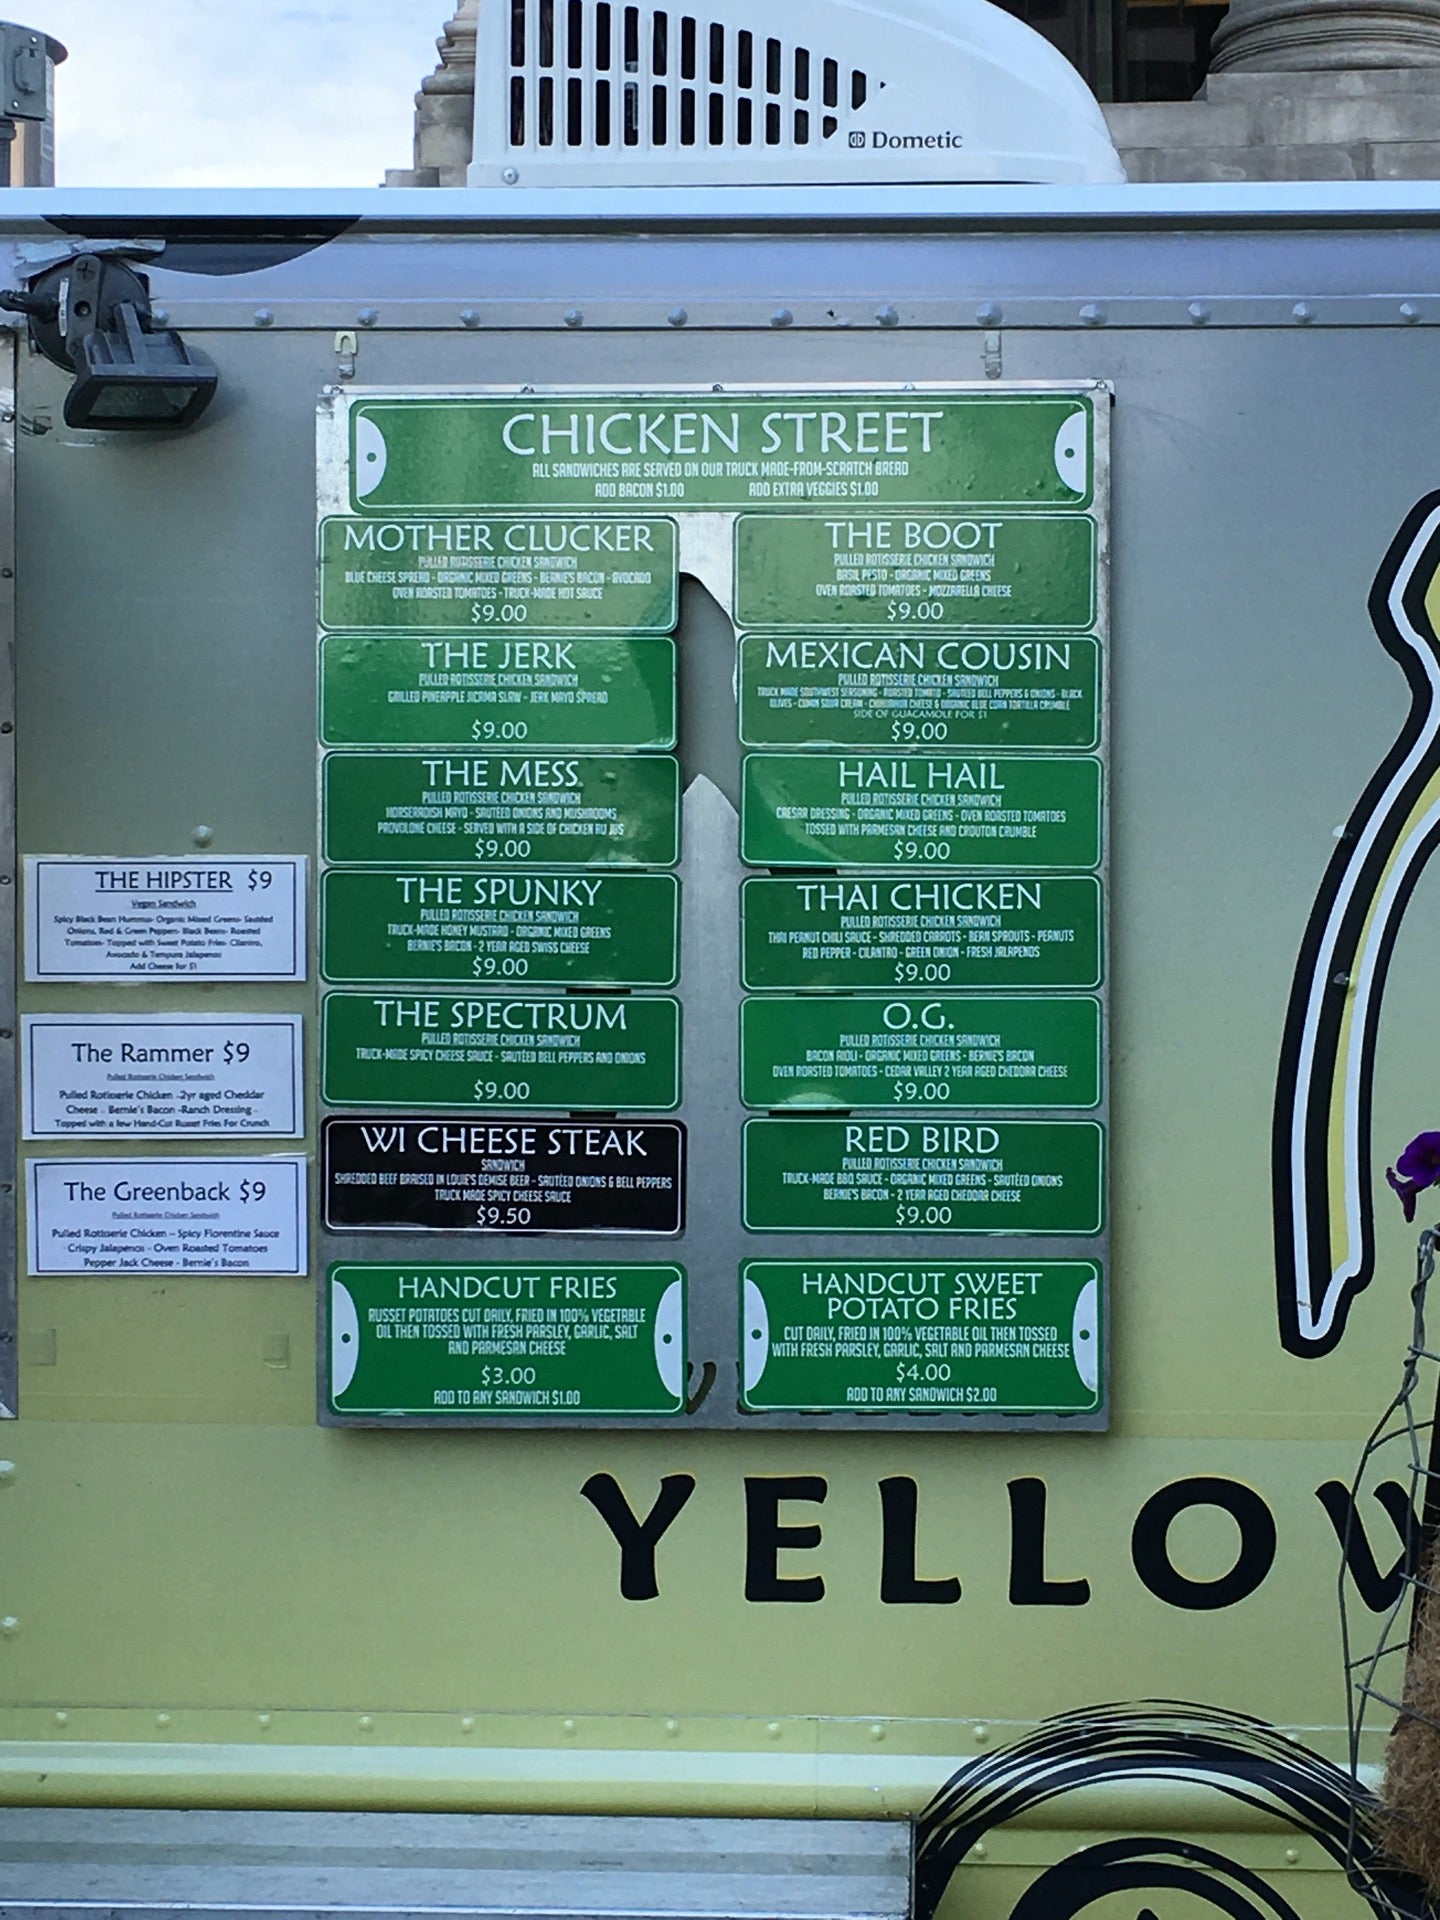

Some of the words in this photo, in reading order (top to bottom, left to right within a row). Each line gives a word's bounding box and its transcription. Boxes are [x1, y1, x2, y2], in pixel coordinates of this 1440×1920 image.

[872, 131, 962, 149] Dometic
[503, 413, 739, 455] CHICKEN
[761, 411, 944, 453] STREET
[532, 463, 551, 478] ALL
[552, 462, 619, 478] SANDWICHES
[621, 462, 641, 478] ARE
[643, 462, 682, 477] SERVED
[684, 462, 699, 477] ON
[701, 462, 723, 477] OUR
[725, 461, 759, 477] TRUCK
[761, 461, 873, 476] MADE-FROM-SCRATCH
[875, 461, 909, 476] BREAD
[595, 483, 616, 497] ADD
[618, 482, 653, 497] BACON
[656, 481, 684, 498] $1.00
[749, 481, 770, 497] ADD
[773, 481, 804, 497] EXTRA
[806, 481, 848, 496] VEGGIES
[850, 481, 878, 497] $1.00
[344, 525, 494, 551] MOTHER
[504, 525, 654, 551] CLUCKER
[824, 522, 892, 549] THE
[904, 522, 1003, 549] BOOT
[471, 602, 527, 624] $9.00
[887, 599, 944, 621] $9.00
[421, 642, 488, 668] THE
[498, 642, 577, 669] JERK
[765, 642, 925, 669] MEXICAN
[937, 642, 1071, 670] COUSIN
[471, 719, 528, 741] $9.00
[891, 720, 947, 742] $9.00
[422, 760, 489, 786] THE
[500, 761, 579, 787] MESS
[839, 761, 916, 789] HAIL
[928, 762, 1005, 789] HAIL
[475, 837, 531, 859] $9.00
[894, 839, 951, 861] $9.00
[95, 871, 139, 890] THE
[147, 871, 232, 890] HIPSTER
[248, 869, 272, 891] $9
[396, 877, 463, 904] THE
[474, 877, 602, 906] SPUNKY
[796, 884, 878, 911] THAI
[890, 883, 1041, 910] CHICKEN
[473, 955, 528, 977] $9.00
[895, 962, 951, 983] $9.00
[373, 1000, 440, 1027] THE
[451, 1001, 627, 1031] SPECTRUM
[883, 1002, 955, 1030] O.G.
[71, 1043, 113, 1063] The
[121, 1043, 214, 1063] Rammer
[223, 1040, 250, 1065] $9
[474, 1079, 530, 1101] $9.00
[894, 1080, 950, 1102] $9.00
[360, 1126, 405, 1152] WI
[417, 1127, 536, 1154] CHEESE
[547, 1128, 648, 1157] STEAK
[846, 1126, 909, 1152] RED
[923, 1126, 999, 1153] BIRD
[481, 1158, 525, 1172] SANDWICH
[63, 1181, 106, 1201] The
[114, 1181, 230, 1201] Greenback
[240, 1179, 266, 1204] $9
[477, 1205, 531, 1226] $9.50
[896, 1204, 952, 1226] $9.00
[52, 1228, 82, 1238] Pulled
[129, 1228, 167, 1238] Chicken
[178, 1229, 201, 1240] Spicy
[204, 1229, 251, 1238] Florentine
[253, 1228, 280, 1238] Sauce
[83, 1258, 117, 1268] Pepper
[119, 1258, 139, 1267] Jack
[141, 1257, 174, 1267] Cheese
[221, 1258, 250, 1267] Bacon
[399, 1276, 541, 1299] HANDCUT
[550, 1276, 617, 1299] FRIES
[802, 1272, 945, 1295] HANDCUT
[954, 1272, 1043, 1295] SWEET
[368, 1308, 406, 1322] RUSSET
[409, 1308, 459, 1322] POTATOES
[462, 1308, 481, 1322] CUT
[484, 1308, 514, 1324] DAILY,
[516, 1308, 544, 1322] FRIED
[560, 1308, 589, 1322] 100%
[592, 1308, 646, 1322] VEGETABLE
[828, 1297, 939, 1320] POTATO
[950, 1297, 1017, 1320] FRIES
[376, 1324, 392, 1339] OIL
[394, 1324, 420, 1339] THEN
[422, 1324, 460, 1339] TOSSED
[463, 1324, 490, 1339] WITH
[492, 1324, 523, 1339] FRESH
[525, 1324, 572, 1341] PARSLEY,
[574, 1324, 613, 1341] GARLIC,
[614, 1324, 638, 1339] SALT
[784, 1326, 805, 1341] CUT
[806, 1326, 836, 1343] DAILY,
[838, 1326, 867, 1341] FRIED
[882, 1326, 913, 1341] 100%
[914, 1326, 970, 1341] VEGETABLE
[972, 1326, 988, 1341] OIL
[989, 1326, 1016, 1341] THEN
[1017, 1326, 1057, 1341] TOSSED
[448, 1340, 469, 1355] AND
[471, 1340, 527, 1355] PARMESAN
[529, 1340, 566, 1355] CHEESE
[772, 1343, 799, 1358] WITH
[801, 1343, 834, 1358] FRESH
[836, 1343, 881, 1360] PARSLEY,
[883, 1343, 923, 1360] GARLIC,
[925, 1343, 949, 1358] SALT
[951, 1343, 972, 1358] AND
[973, 1343, 1030, 1358] PARMESAN
[1032, 1343, 1070, 1358] CHEESE
[482, 1365, 536, 1386] $3.00
[896, 1361, 951, 1383] $4.00
[434, 1390, 455, 1405] ADD
[457, 1390, 470, 1405] TO
[473, 1390, 493, 1404] ANY
[495, 1390, 550, 1405] SANDWICH
[552, 1390, 580, 1406] $1.00
[846, 1387, 868, 1402] ADD
[870, 1387, 884, 1402] TO
[886, 1387, 906, 1402] ANY
[909, 1387, 964, 1402] SANDWICH
[966, 1386, 997, 1402] $2.00
